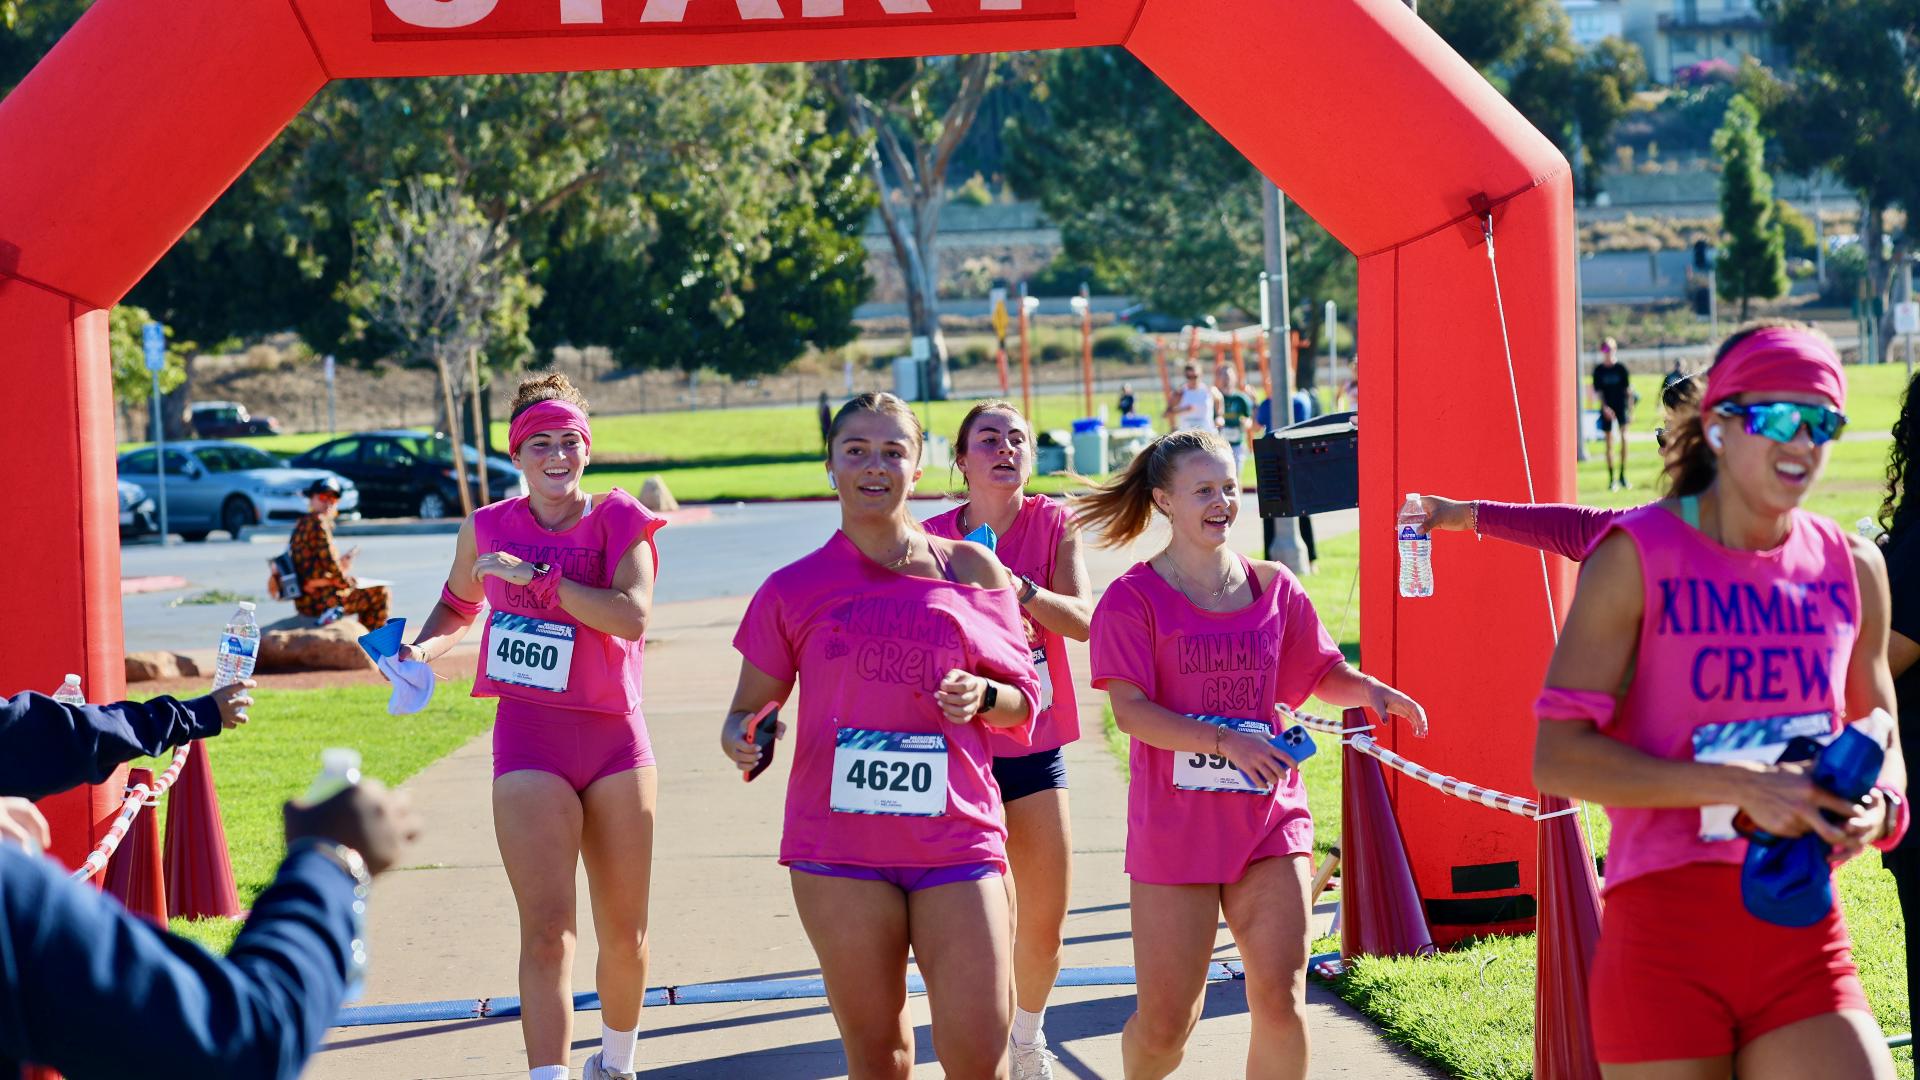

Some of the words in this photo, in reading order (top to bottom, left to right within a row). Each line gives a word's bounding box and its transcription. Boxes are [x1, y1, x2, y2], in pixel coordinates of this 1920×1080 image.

[1658, 578, 1854, 636] KIMMIE'S
[496, 637, 559, 671] 4660
[1691, 646, 1834, 702] CREW
[846, 759, 932, 793] 4620
[1189, 752, 1237, 771] 39
